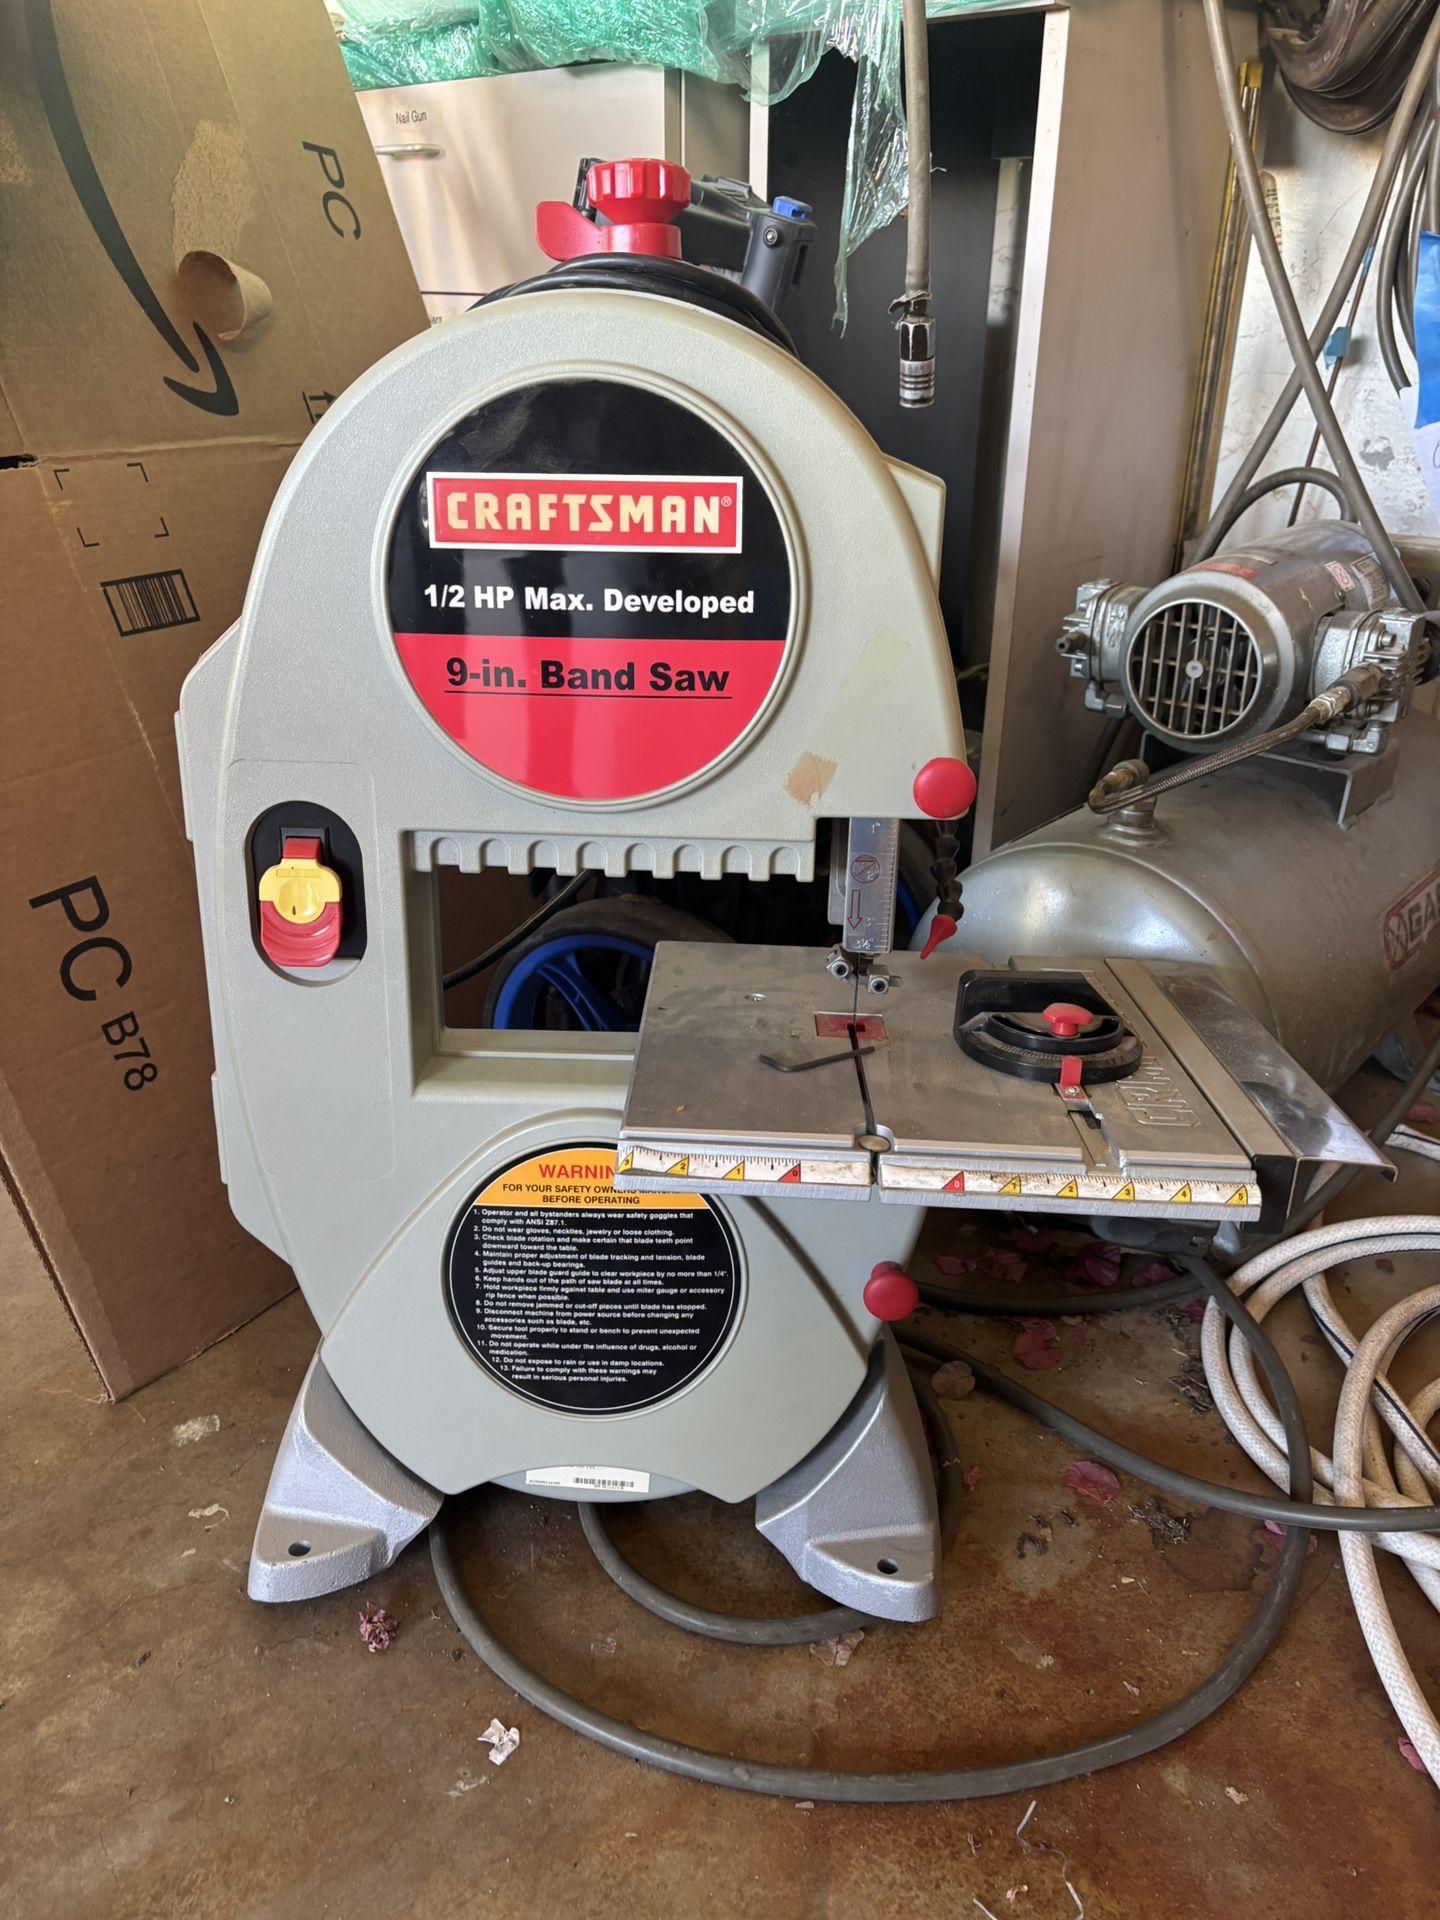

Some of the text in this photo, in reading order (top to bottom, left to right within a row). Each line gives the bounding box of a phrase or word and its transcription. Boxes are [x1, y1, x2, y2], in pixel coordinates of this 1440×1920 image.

[395, 110, 427, 124] Nail Gun
[301, 141, 362, 240] PC
[424, 584, 754, 618] 1/2 HP Max. Developed
[446, 657, 730, 692] 9-in. Band Saw
[28, 875, 158, 1092] PC B78
[538, 1164, 616, 1179] WARNIN
[502, 1184, 522, 1192] FOR
[525, 1184, 552, 1193] YOUR
[555, 1185, 592, 1194] SAFETY
[542, 1195, 640, 1205] BEFORE OPERATING
[481, 1208, 513, 1216] Operator
[481, 1217, 508, 1225] comply
[501, 1284, 538, 1292] workpiece
